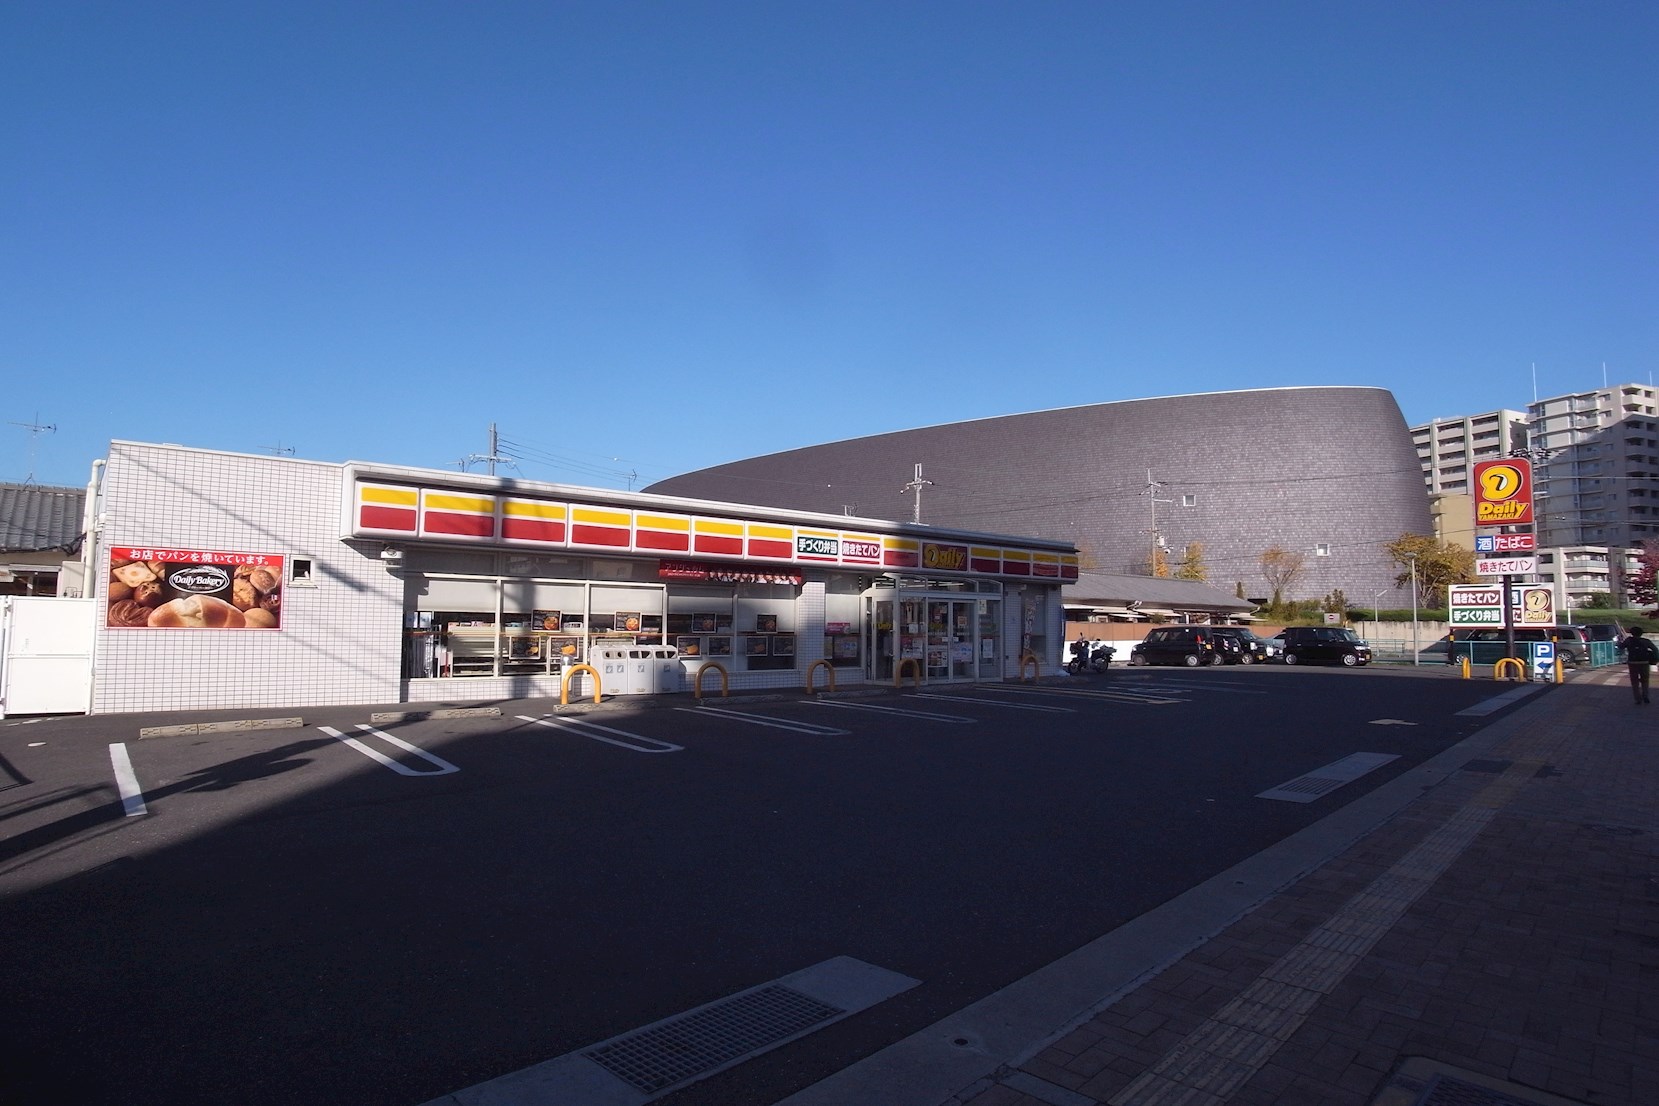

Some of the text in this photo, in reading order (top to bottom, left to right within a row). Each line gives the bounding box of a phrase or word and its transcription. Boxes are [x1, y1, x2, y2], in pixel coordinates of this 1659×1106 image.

[1479, 501, 1529, 519] Daily
[798, 538, 838, 555] 手づくり弁当
[842, 543, 880, 557] 焼きたてパン
[1478, 537, 1533, 551] 酒 たばこ
[129, 549, 269, 566] お店でパンを焼いています。
[924, 543, 965, 568] Daily
[1479, 560, 1533, 572] 焼きたてパン
[174, 575, 225, 587] Daily Bakery
[1453, 592, 1499, 604] 焼きたてパン
[1453, 610, 1500, 621] 手づくり弁当
[1525, 610, 1552, 621] Daily
[1537, 645, 1550, 656] P
